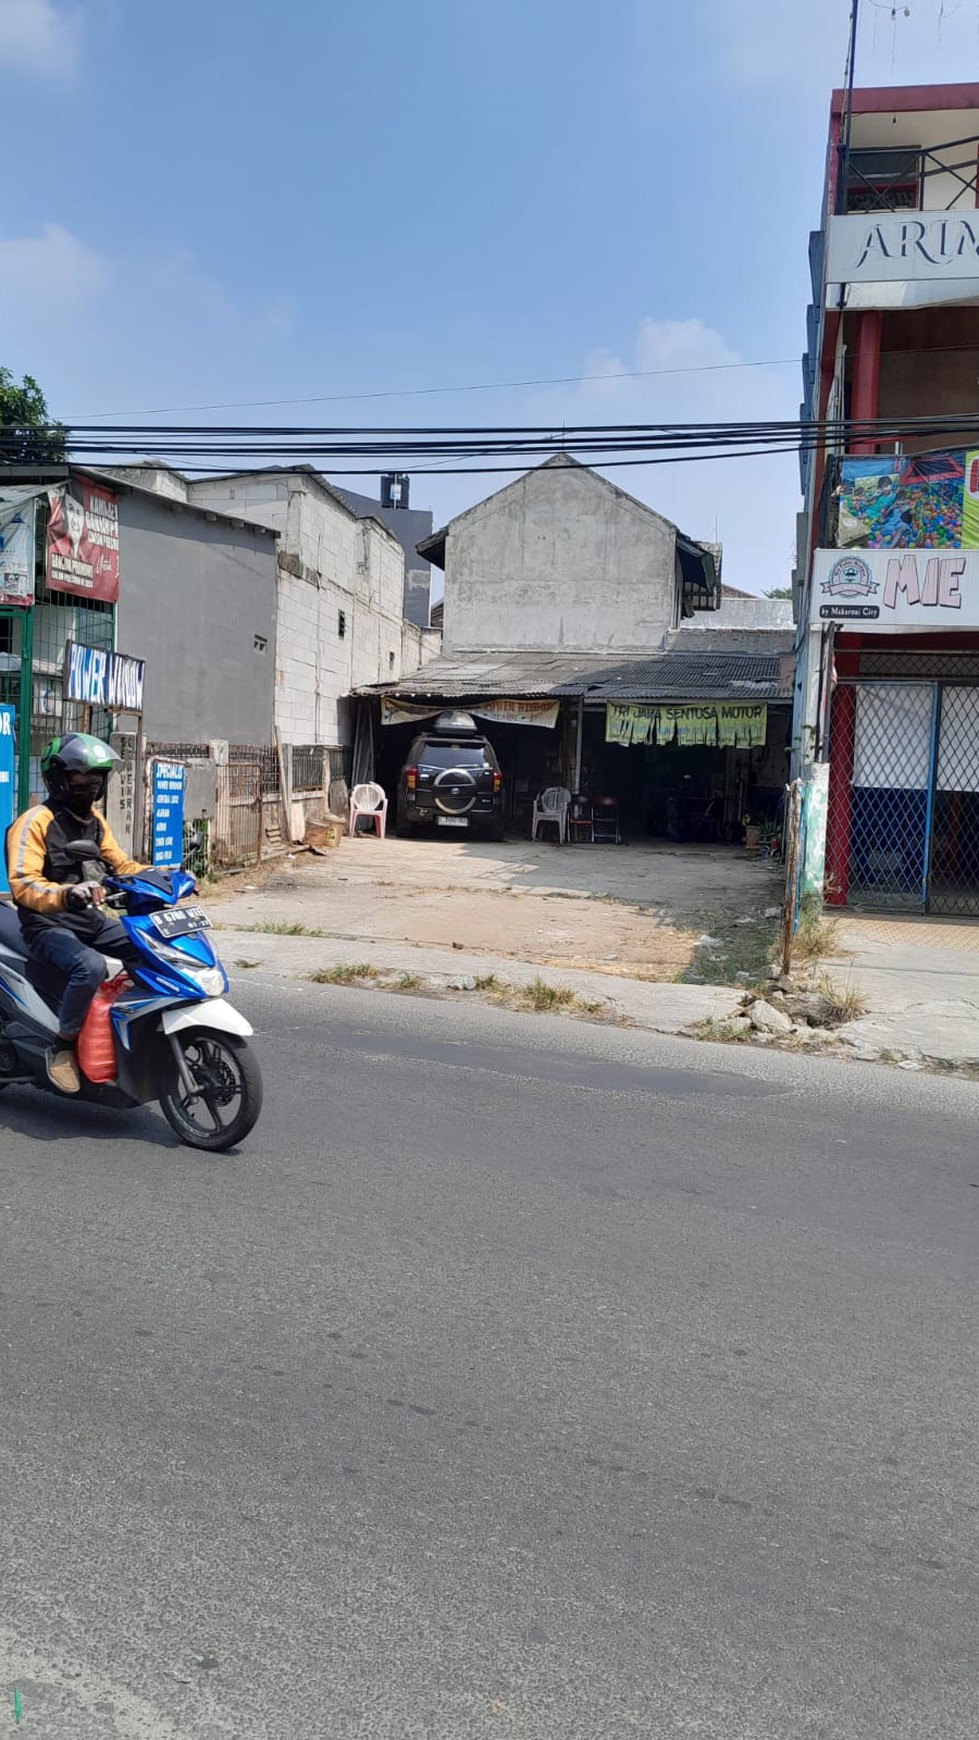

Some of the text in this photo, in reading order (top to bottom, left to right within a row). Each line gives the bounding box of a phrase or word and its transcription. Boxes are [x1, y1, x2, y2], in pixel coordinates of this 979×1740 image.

[882, 554, 967, 609] MIE
[68, 643, 107, 705] POWER
[665, 706, 718, 720] SENTOSA
[721, 705, 764, 719] MOTOR
